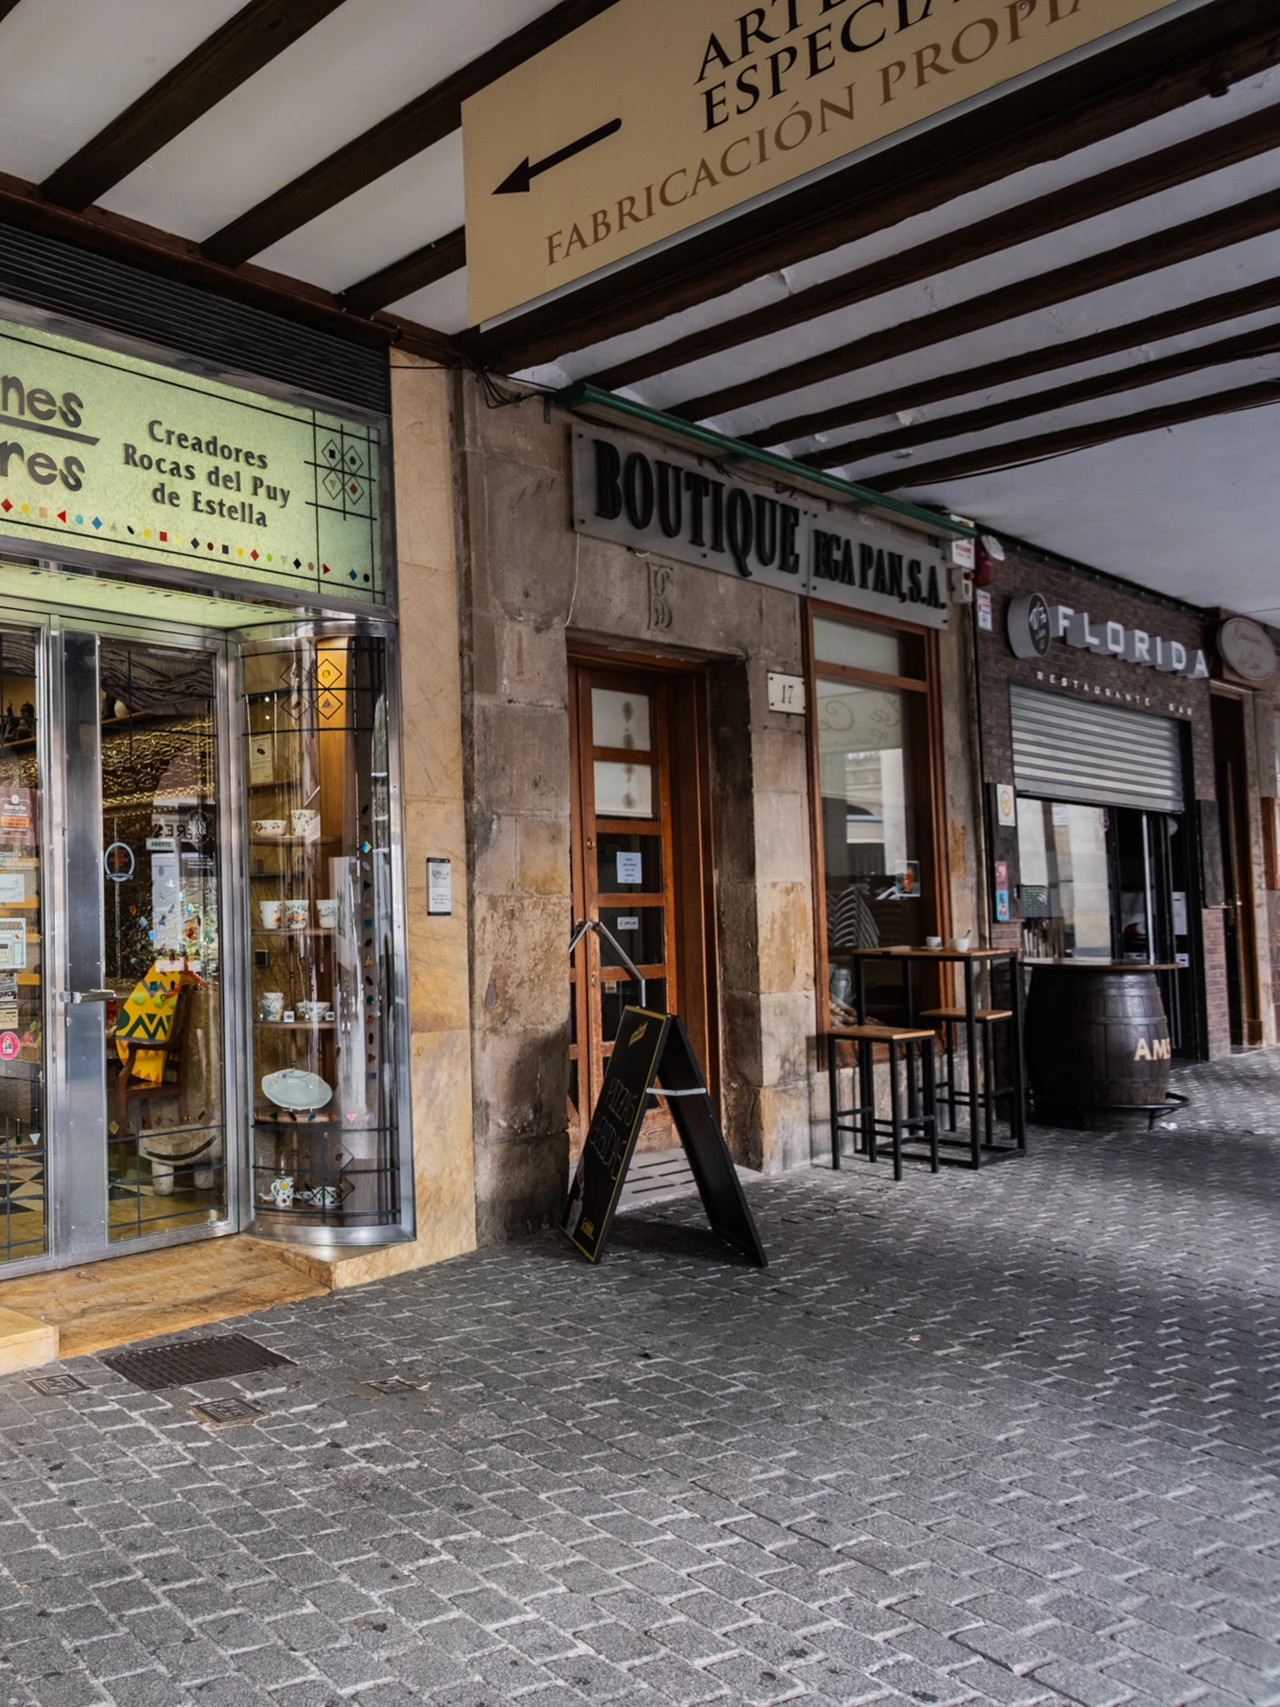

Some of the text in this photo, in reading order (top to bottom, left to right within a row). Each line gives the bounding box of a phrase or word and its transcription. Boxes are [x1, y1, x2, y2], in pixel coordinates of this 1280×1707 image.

[693, 0, 852, 85] ART
[700, 0, 971, 133] ESPECI
[545, 0, 1083, 267] FABRICACIÓN PROPI
[123, 442, 291, 509] Rocas del Puy
[147, 419, 268, 470] Creadores
[152, 482, 268, 528] de Estella
[594, 439, 801, 578] BOUTIQUE
[813, 529, 857, 587] EGA
[907, 557, 947, 609] S.A.
[1057, 604, 1210, 679] FLORIDA
[781, 684, 795, 704] 17
[1036, 671, 1193, 716] RESTAURANTE BAR
